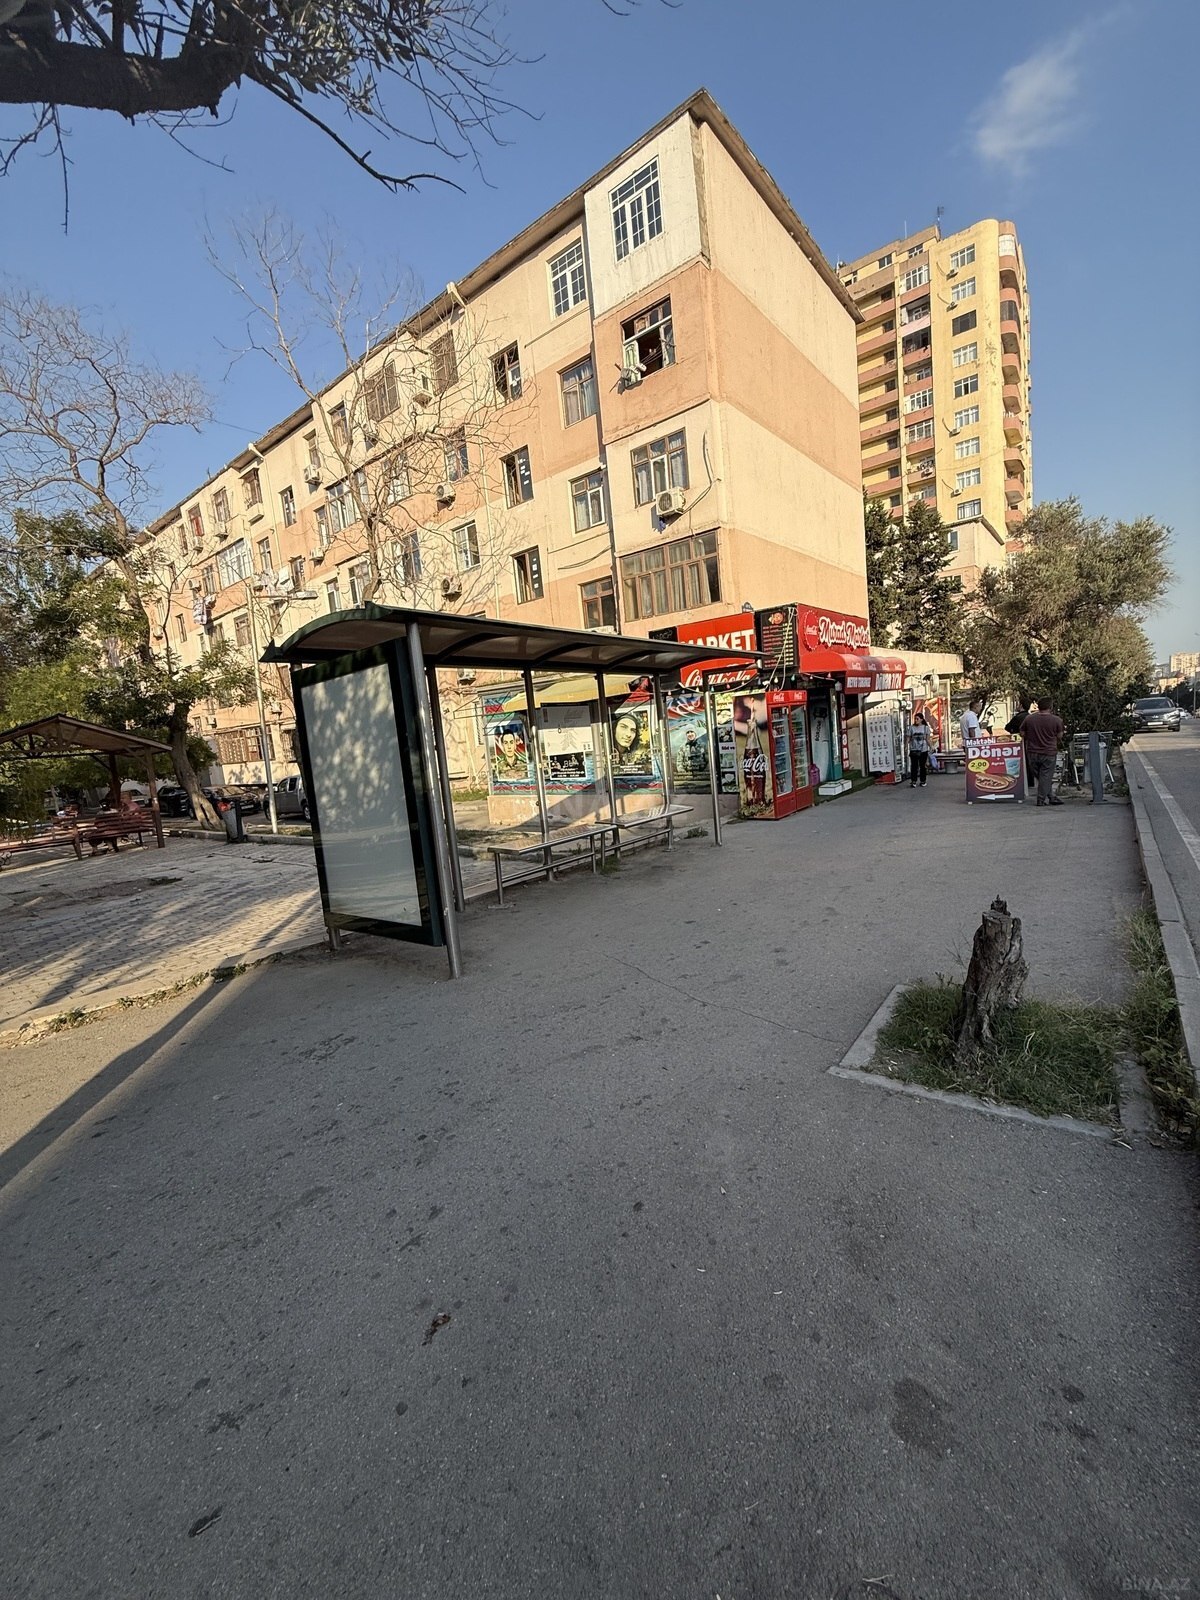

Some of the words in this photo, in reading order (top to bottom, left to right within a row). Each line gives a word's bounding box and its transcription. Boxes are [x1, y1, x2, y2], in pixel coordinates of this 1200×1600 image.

[680, 629, 754, 651] RKET
[966, 738, 996, 746] Məktəbli
[968, 746, 1020, 759] Dönər
